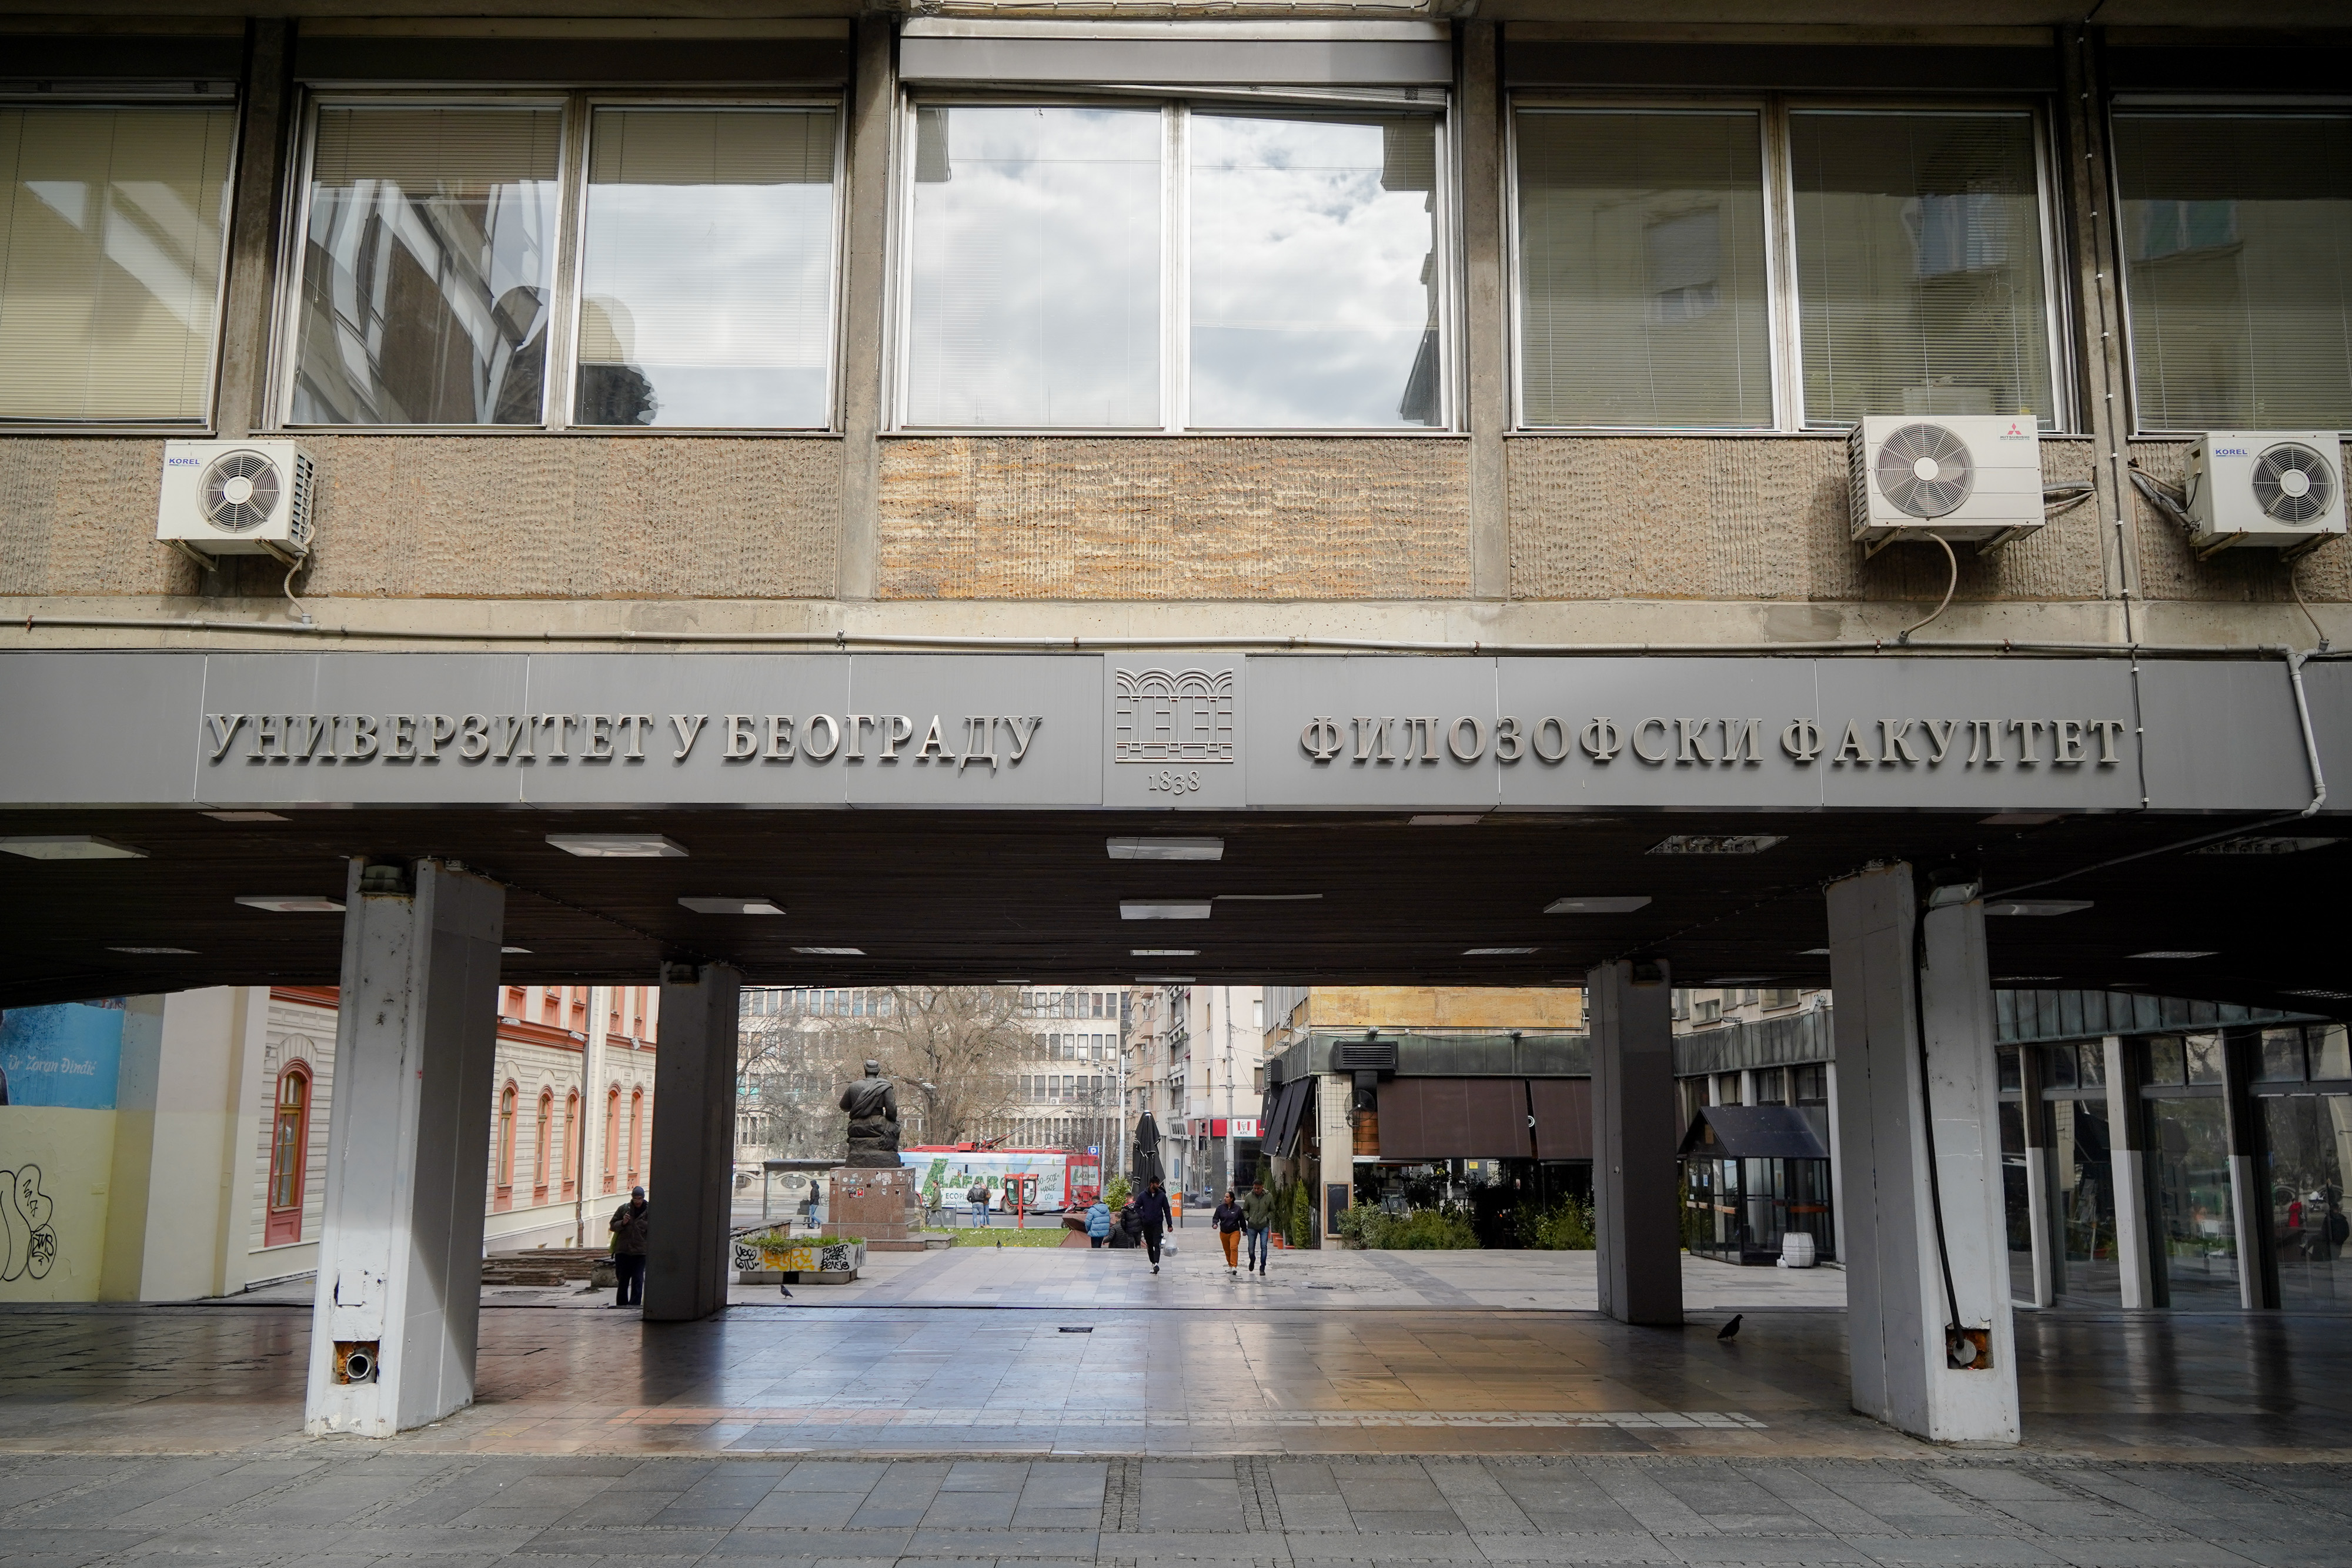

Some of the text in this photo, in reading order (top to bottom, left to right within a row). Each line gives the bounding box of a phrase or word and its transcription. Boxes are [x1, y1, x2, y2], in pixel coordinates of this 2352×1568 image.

[205, 713, 1043, 770] УНИВЕРЗИТЕТ У БЕОГРАДУ
[1301, 715, 2125, 764] ФИЛОЗОФСКИ ФАКУЛТЕТ
[1148, 770, 1201, 794] 1838
[8, 1055, 20, 1070] Dr
[25, 1055, 58, 1072] Zoran
[1040, 1183, 1056, 1193] MANJE
